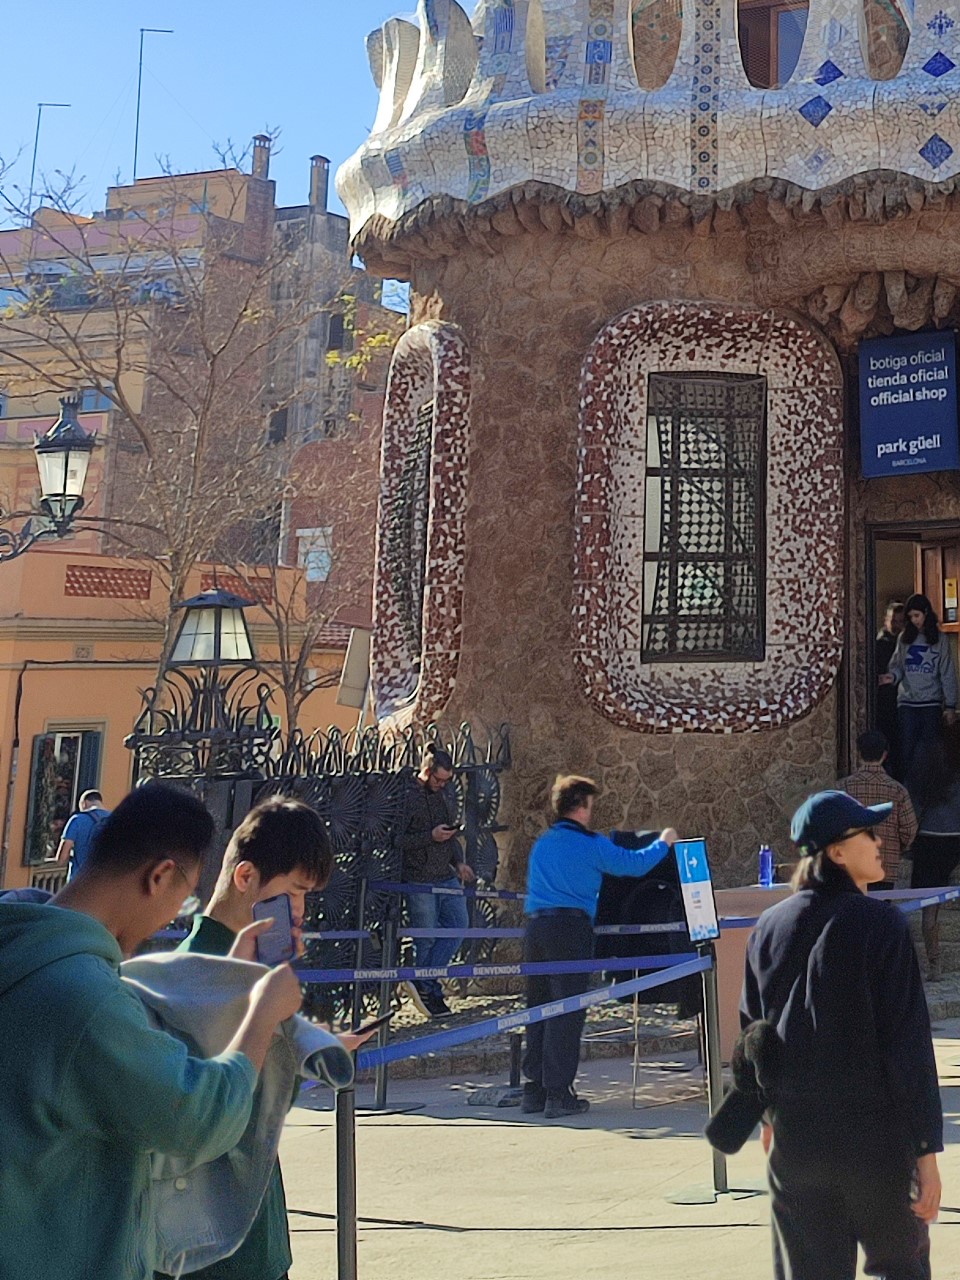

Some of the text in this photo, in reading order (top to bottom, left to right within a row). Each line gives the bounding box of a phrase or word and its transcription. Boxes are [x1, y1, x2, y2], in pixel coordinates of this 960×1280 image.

[869, 348, 945, 371] botiga oficial
[867, 366, 948, 389] tienda oficial
[870, 387, 947, 407] official shop
[877, 434, 941, 458] park güell
[353, 965, 521, 979] BENVINGUTS WELCOME BIENVENIDOS
